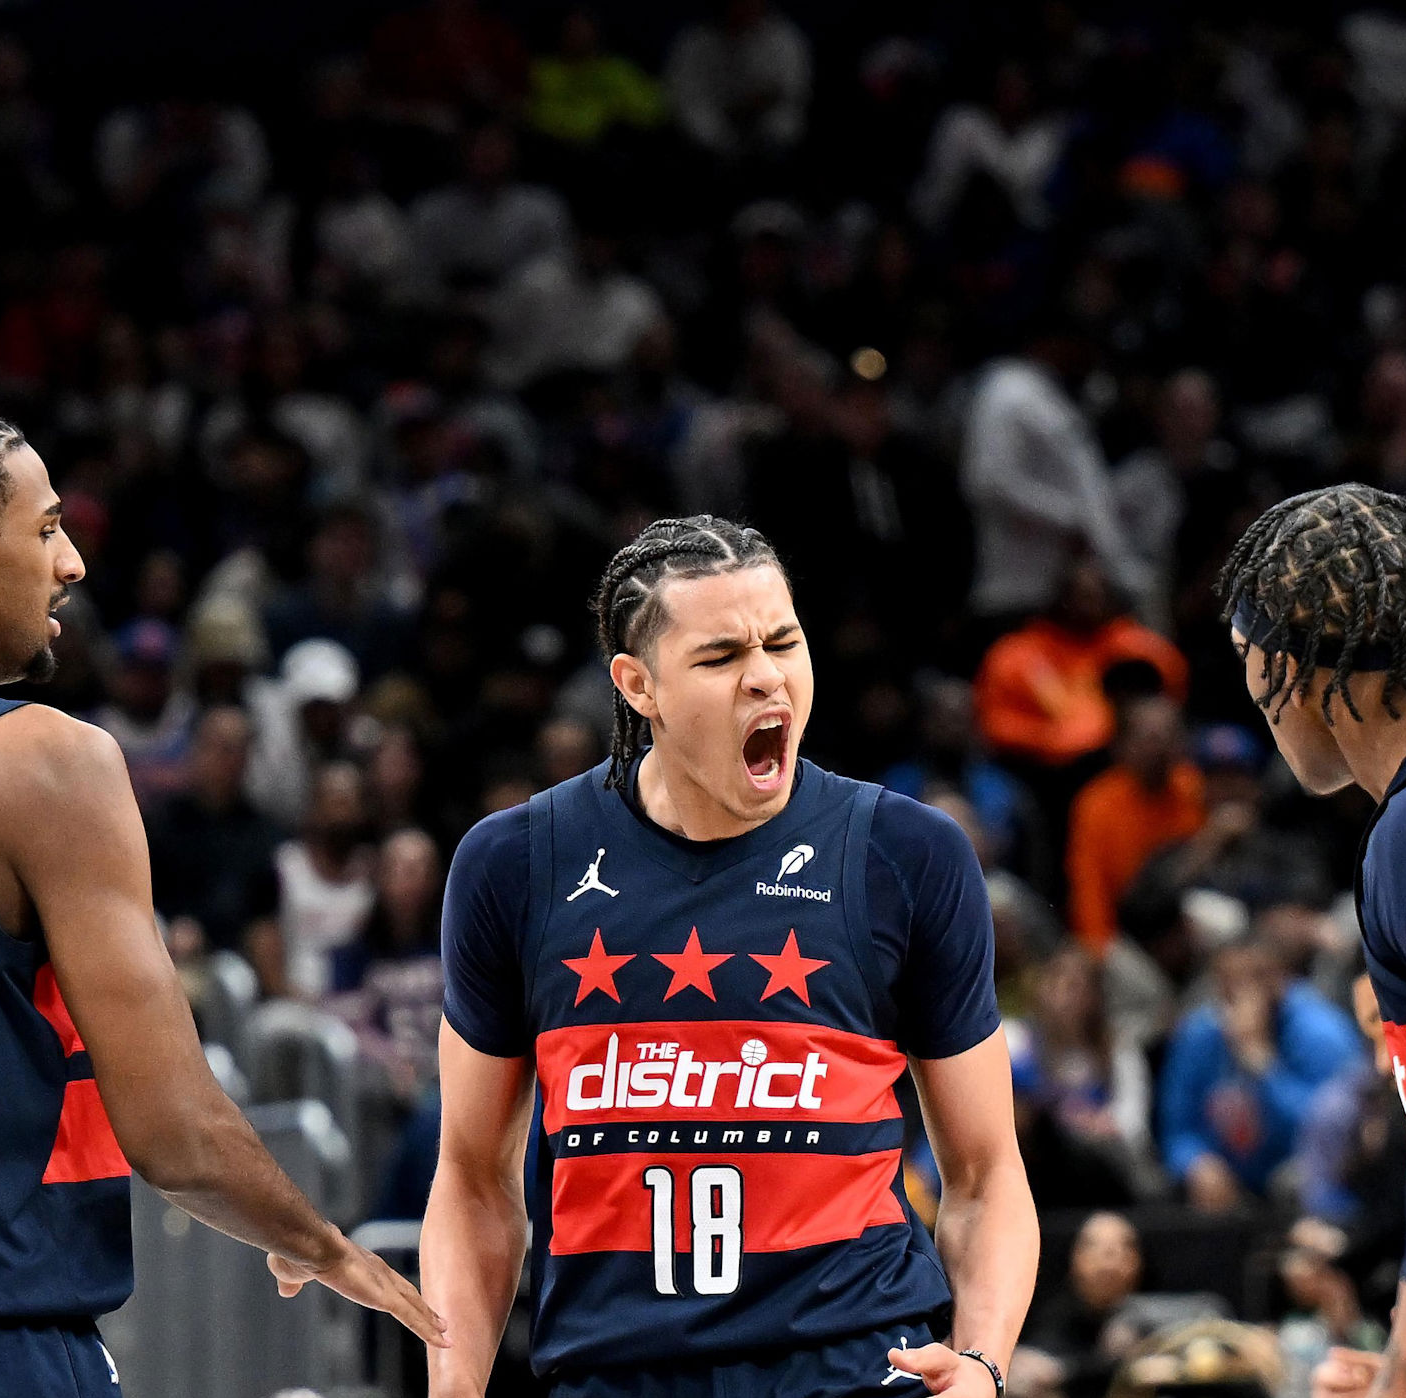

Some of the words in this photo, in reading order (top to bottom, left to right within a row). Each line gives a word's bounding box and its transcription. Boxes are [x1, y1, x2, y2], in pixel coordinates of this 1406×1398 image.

[755, 881, 832, 903] Robinhood
[636, 1042, 681, 1060] THE
[566, 1032, 829, 1111] district
[567, 1132, 605, 1148] OF
[627, 1130, 821, 1145] COLUMBIA
[643, 1164, 743, 1297] 18
